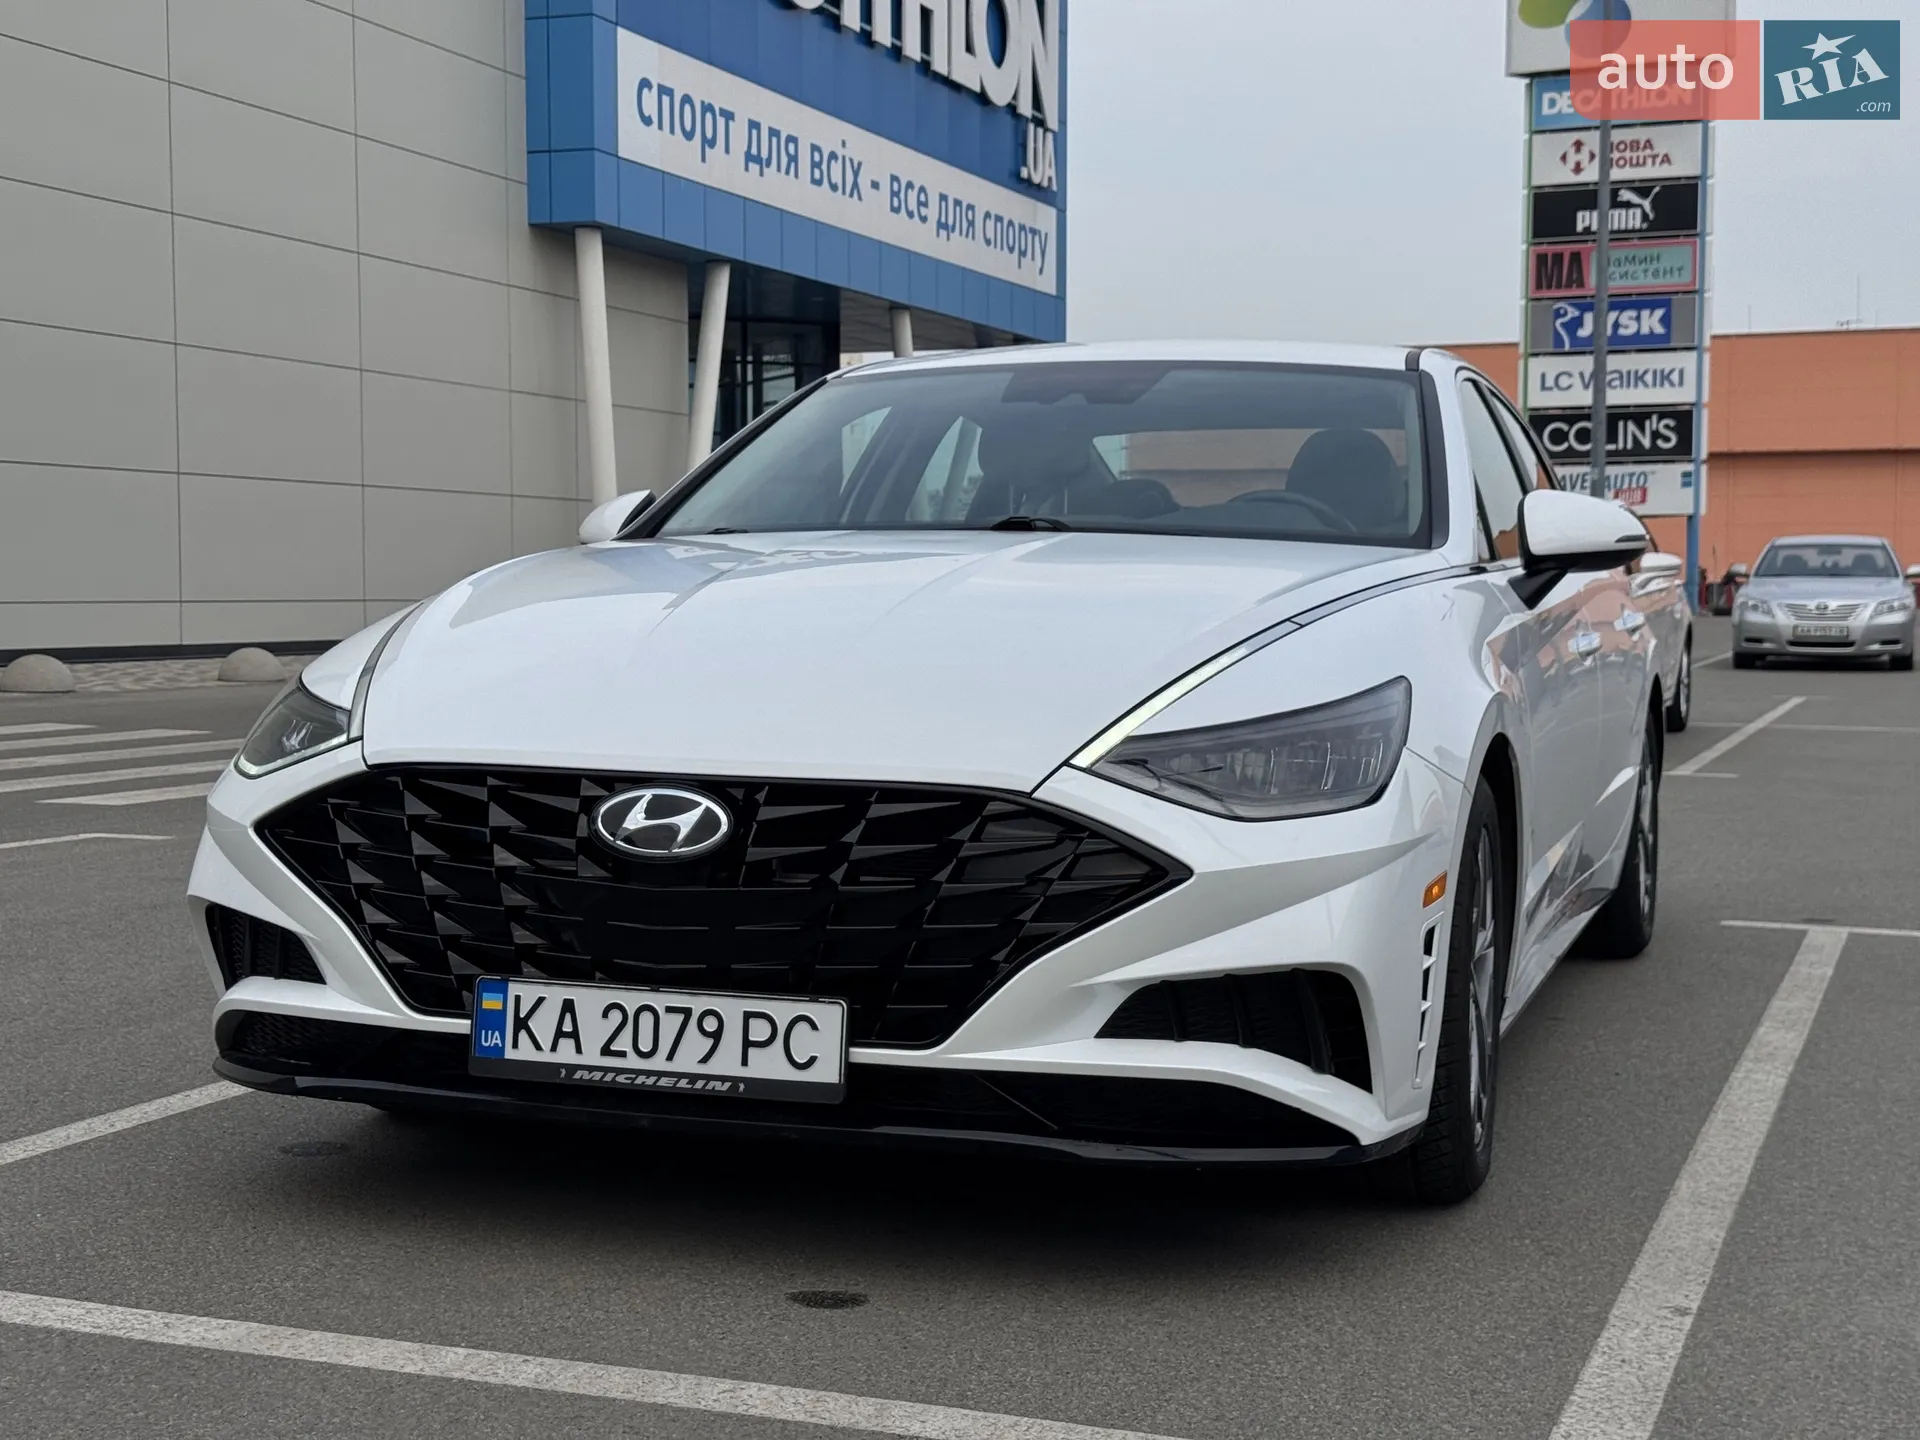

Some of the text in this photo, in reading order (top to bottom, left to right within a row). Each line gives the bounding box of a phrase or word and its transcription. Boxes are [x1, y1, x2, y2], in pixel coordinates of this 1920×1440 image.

[1610, 138, 1655, 153] ОВА
[1020, 123, 1057, 191] .UA
[1610, 152, 1673, 169] ОШТА
[635, 76, 735, 163] спорт
[743, 119, 799, 180] для
[809, 140, 863, 201] всіх
[889, 172, 929, 224] все
[936, 190, 976, 242] для
[982, 208, 1049, 276] спорту
[1540, 371, 1574, 392] LC
[481, 1030, 502, 1047] UA
[511, 994, 820, 1071] KA 2079 PC
[572, 1069, 733, 1092] MICHELIN
